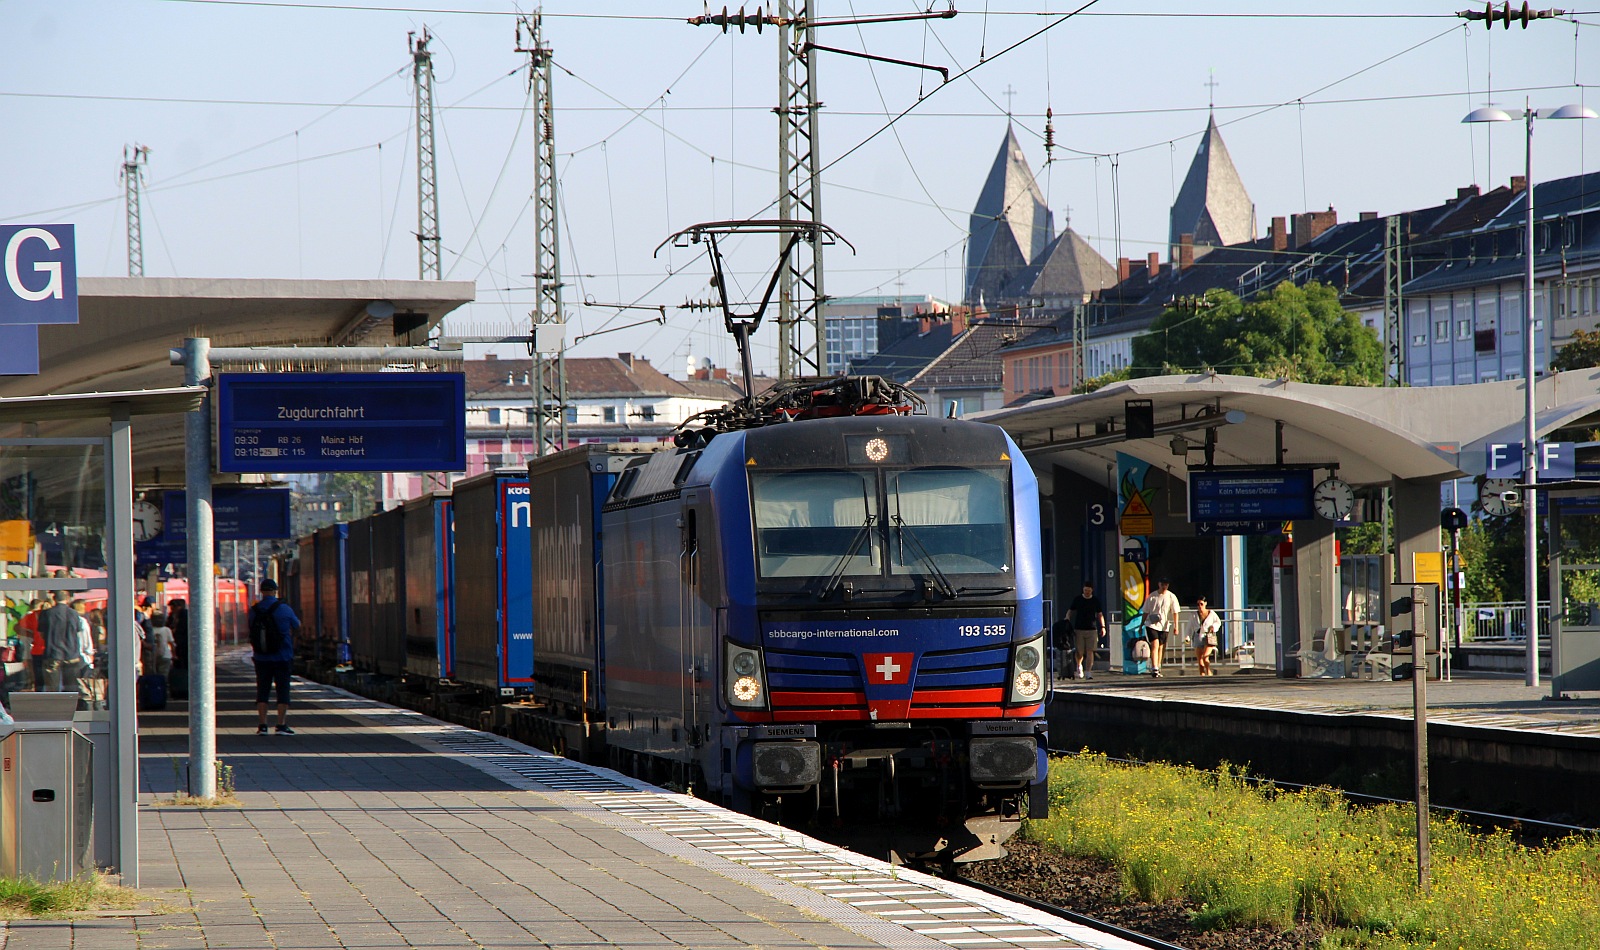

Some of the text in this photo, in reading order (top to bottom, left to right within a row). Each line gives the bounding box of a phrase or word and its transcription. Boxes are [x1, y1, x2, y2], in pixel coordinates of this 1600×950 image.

[5, 227, 63, 301] G
[277, 406, 365, 421] Zugdurchfahrt
[234, 435, 364, 445] 09:30 RB 26 Mainz Hbf
[234, 448, 259, 457] 09:18
[278, 448, 289, 456] EC
[291, 448, 306, 456] 115
[321, 447, 365, 458] Klagenfurt
[1491, 444, 1508, 471] F
[1543, 443, 1560, 470] F
[507, 487, 531, 495] KÖG
[1235, 487, 1278, 495] Messe/Deutz
[511, 500, 532, 528] n
[1091, 503, 1105, 526] 3
[45, 521, 60, 537] 4
[768, 628, 899, 640] sbbcargo-international.com
[958, 624, 1006, 637] 193 535
[512, 633, 533, 641] www
[767, 728, 805, 736] SIEMENS
[985, 724, 1014, 732] Vectron
